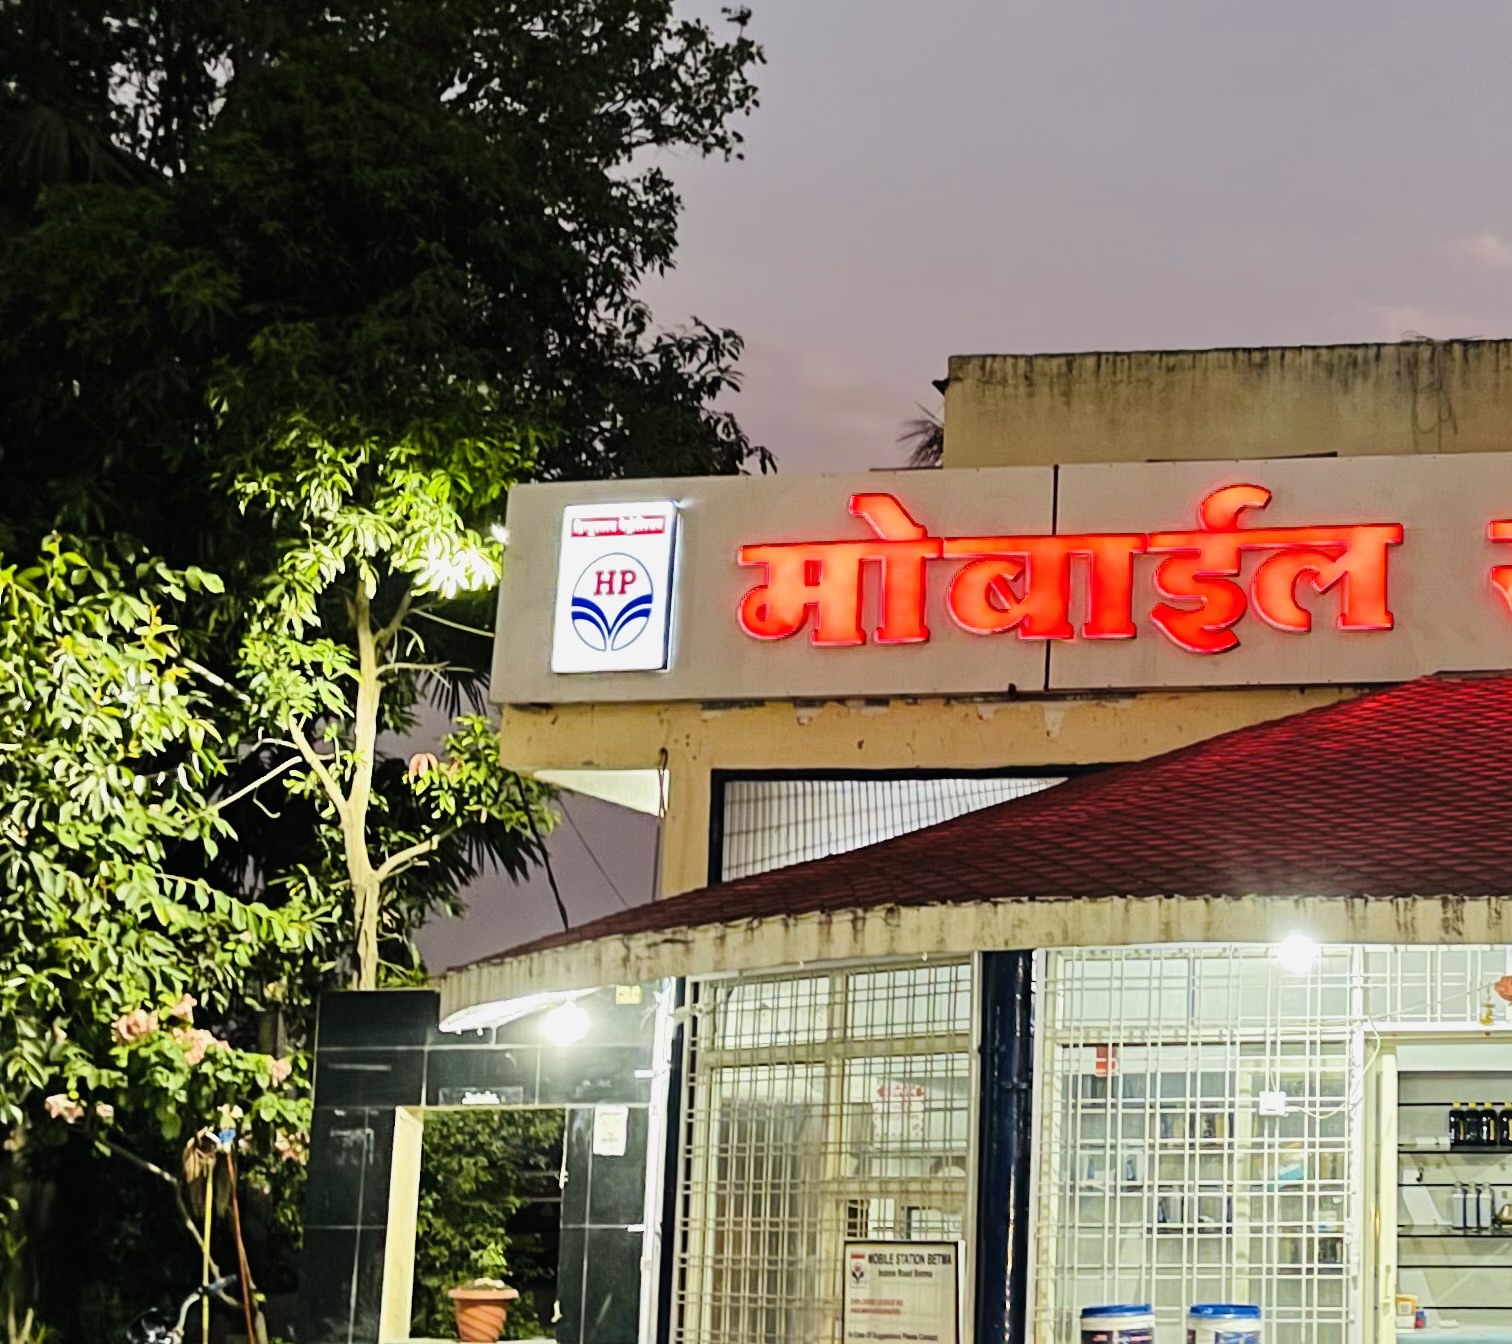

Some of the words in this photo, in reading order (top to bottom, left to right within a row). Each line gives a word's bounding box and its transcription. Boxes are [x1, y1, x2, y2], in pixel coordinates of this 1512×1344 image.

[738, 484, 1403, 653] मोबाईल
[593, 569, 637, 595] HP
[868, 1253, 894, 1265] MOBILE
[896, 1253, 925, 1265] STATION
